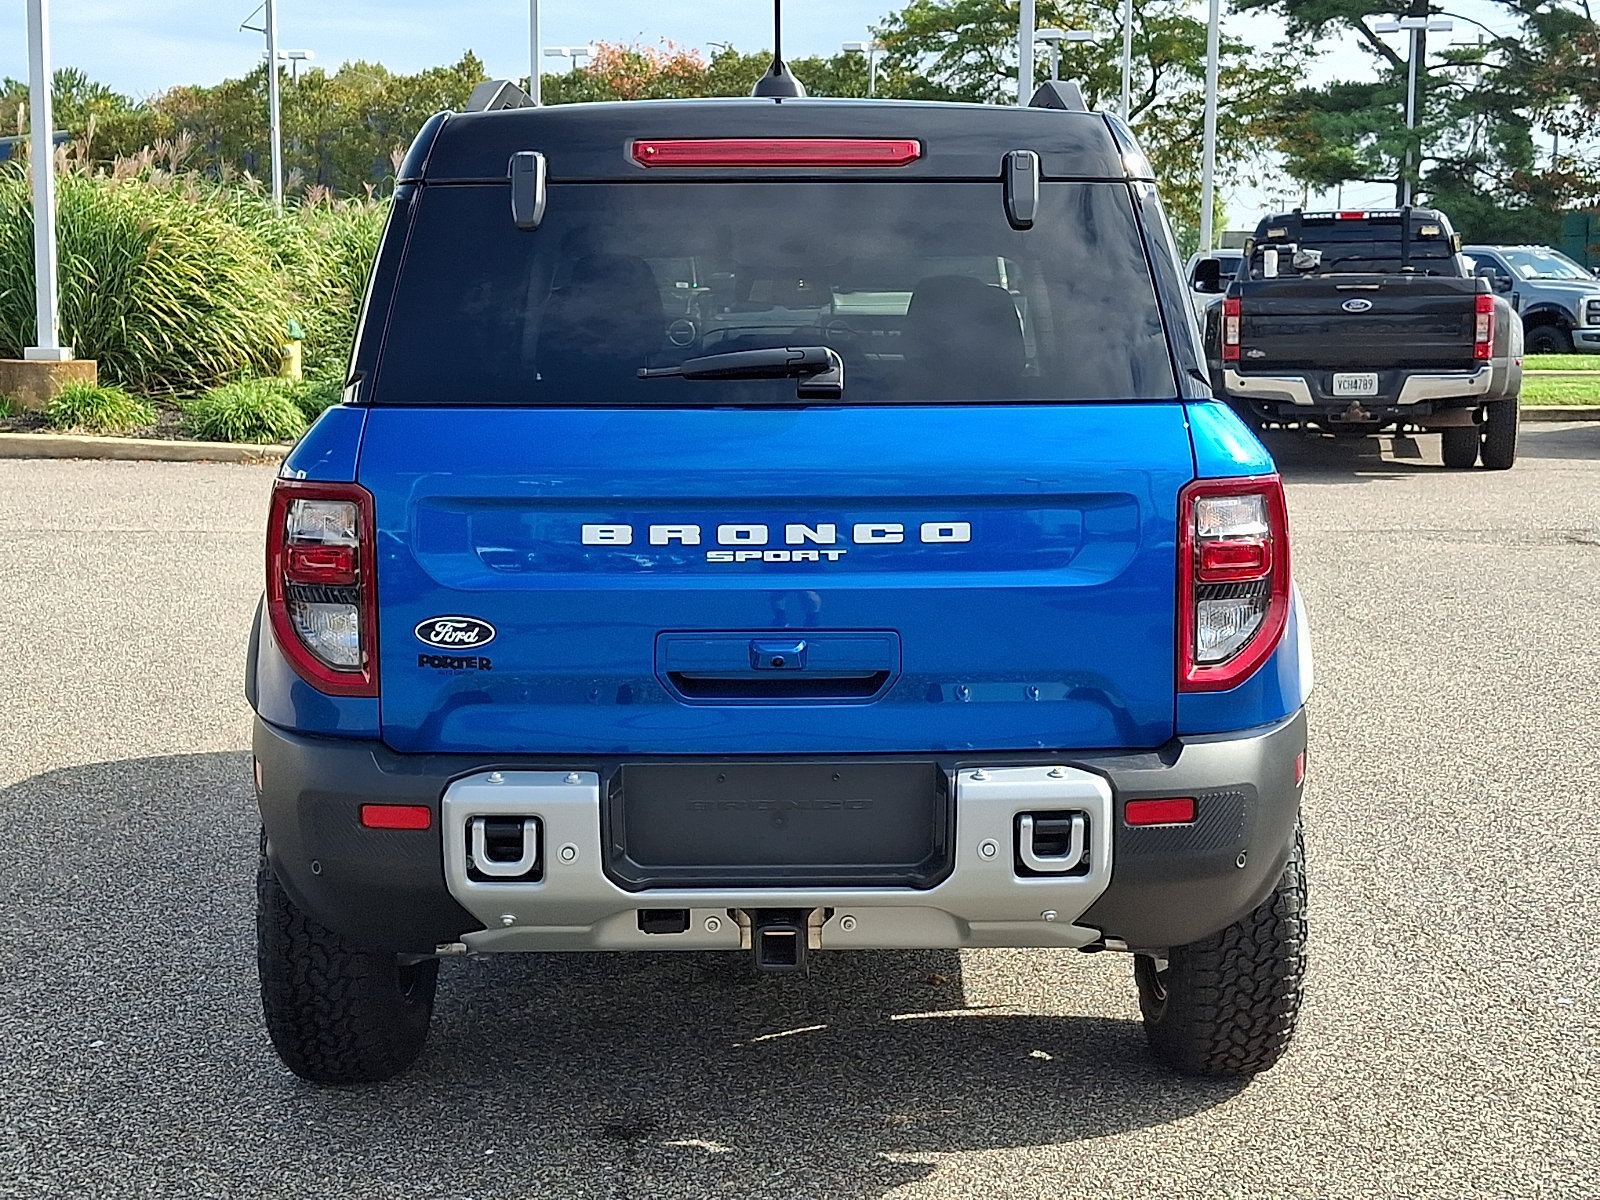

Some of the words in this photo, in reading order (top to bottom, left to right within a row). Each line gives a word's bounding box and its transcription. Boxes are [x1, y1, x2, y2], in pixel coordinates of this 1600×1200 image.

[581, 522, 971, 545] BRONCO
[706, 549, 847, 563] SPORT
[430, 621, 480, 643] Ford
[417, 654, 492, 671] PORTER
[685, 799, 873, 811] BRONCO
